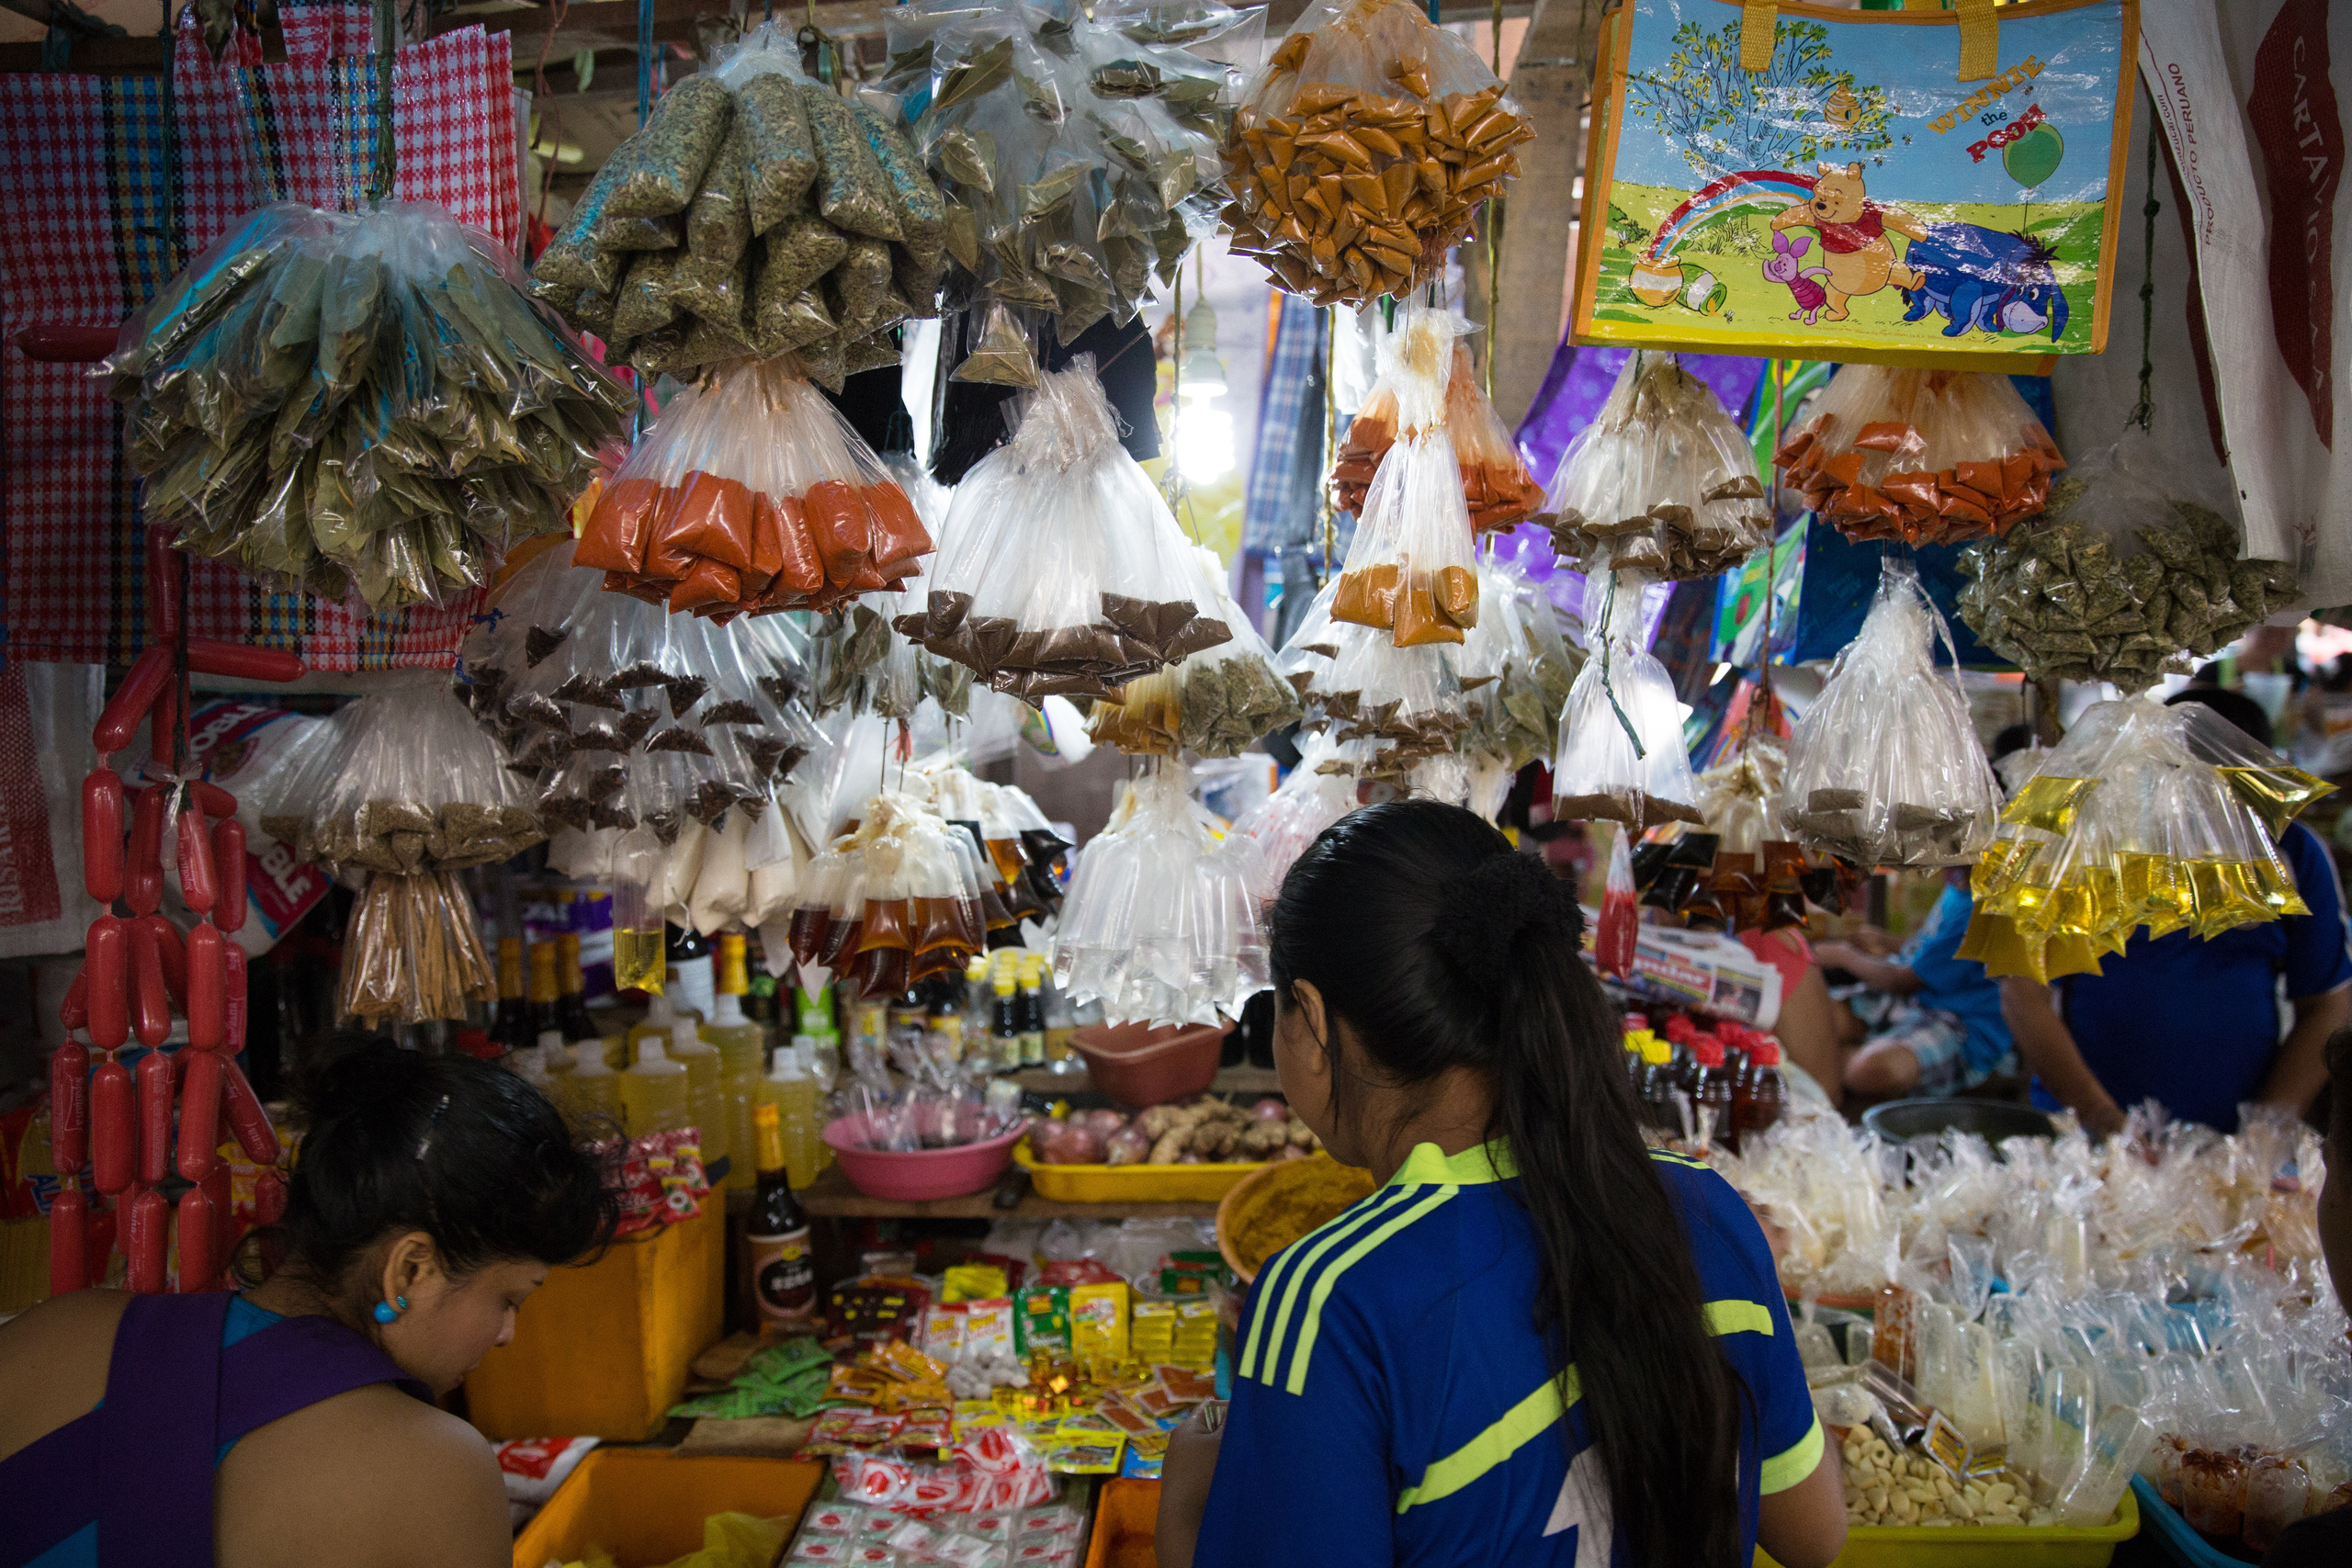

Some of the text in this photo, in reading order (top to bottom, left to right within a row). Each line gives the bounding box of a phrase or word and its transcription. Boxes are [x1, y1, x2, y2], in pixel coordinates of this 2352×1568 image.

[1926, 54, 2046, 135] WINNIE
[1981, 111, 2008, 127] the
[1966, 103, 2048, 164] POOH
[2168, 62, 2214, 245] PRODUCTO PERUANO
[260, 845, 312, 905] BLE
